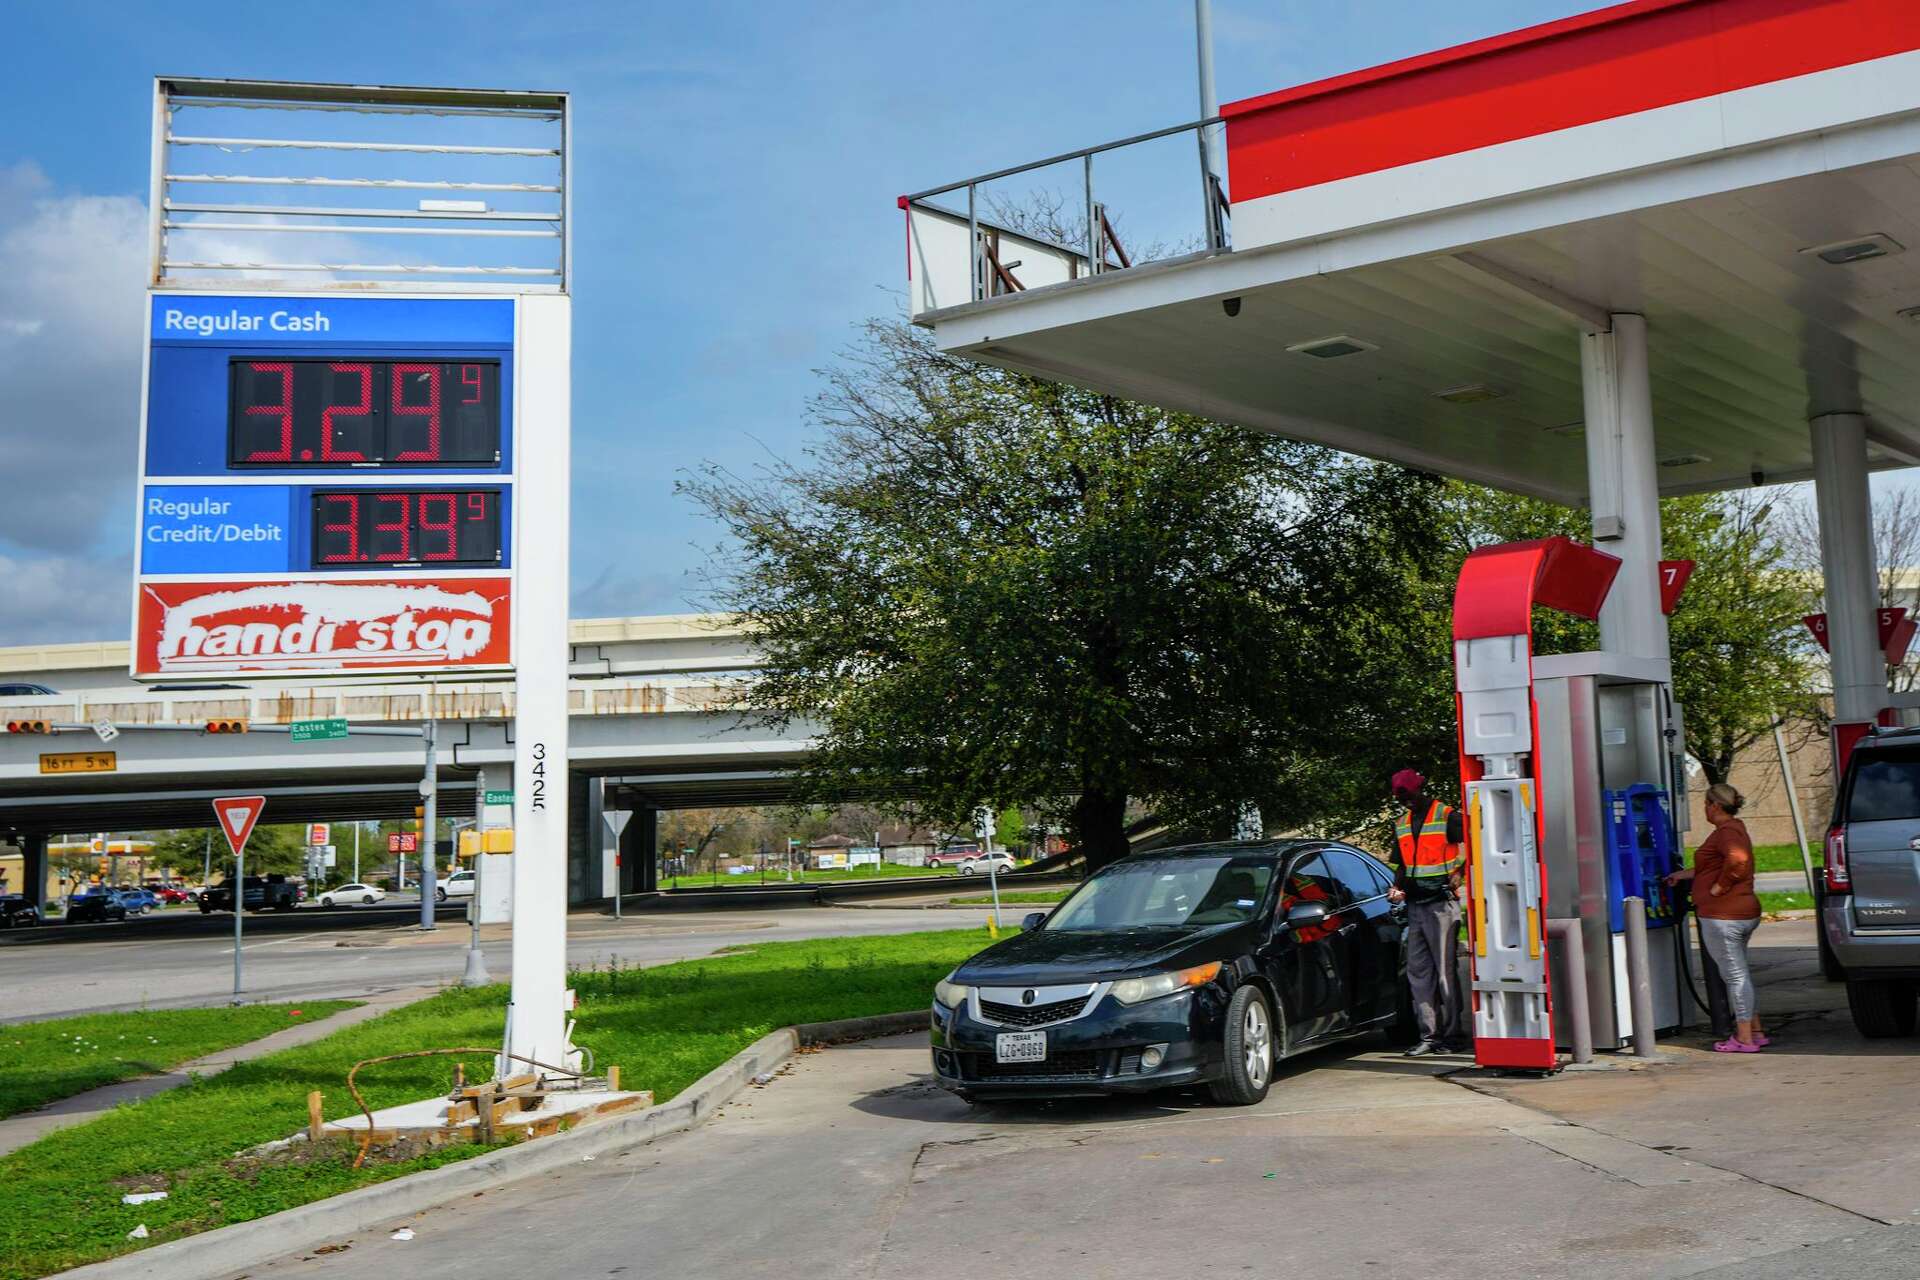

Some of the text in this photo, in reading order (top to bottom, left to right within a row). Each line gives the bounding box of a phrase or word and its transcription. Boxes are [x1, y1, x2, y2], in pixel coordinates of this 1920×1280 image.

[165, 309, 330, 336] Regular Cash
[148, 497, 231, 520] Regular
[147, 523, 282, 542] Credit/Debit
[1664, 569, 1677, 585] 7
[1815, 619, 1825, 632] 6
[1882, 612, 1892, 626] 5
[161, 610, 492, 661] handi stop
[292, 723, 325, 732] Eastex
[46, 757, 110, 769] 16 FT 5 IN
